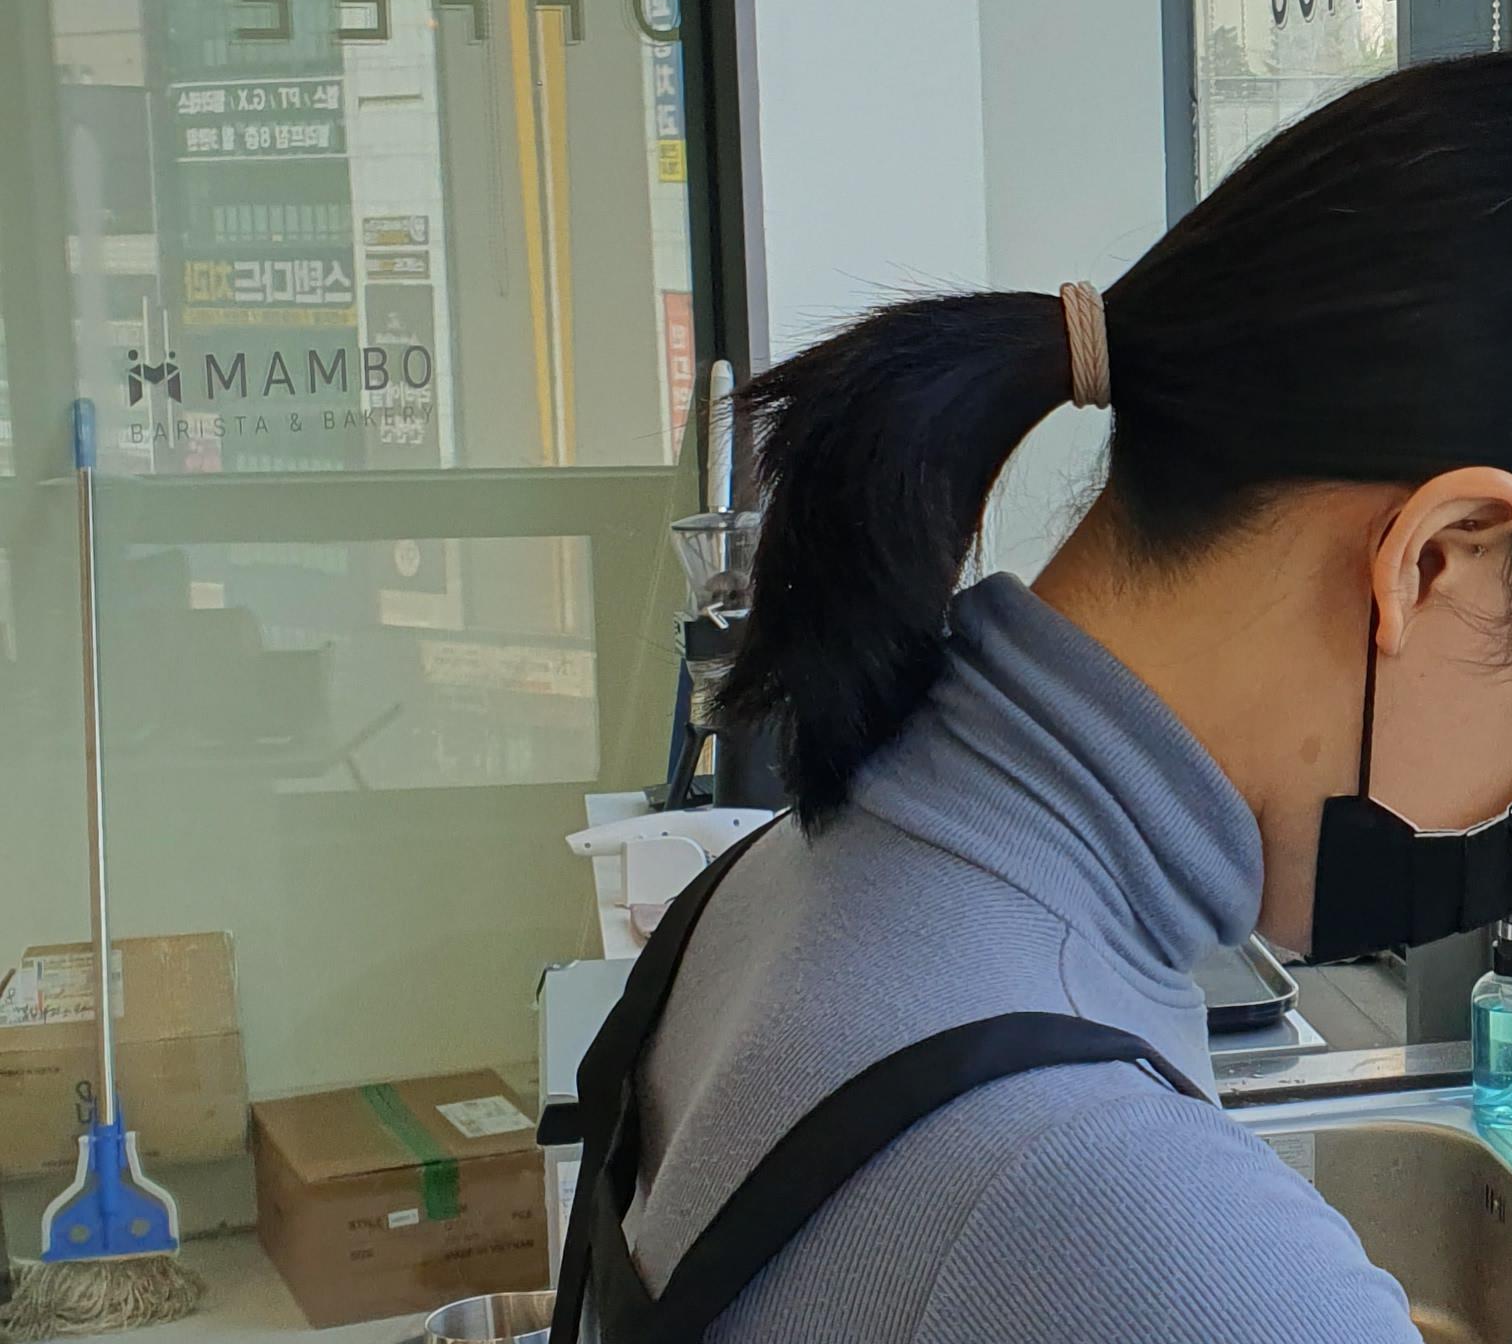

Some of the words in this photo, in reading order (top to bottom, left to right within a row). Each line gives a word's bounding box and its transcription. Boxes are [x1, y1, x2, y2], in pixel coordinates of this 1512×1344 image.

[204, 345, 434, 399] MAMBO
[130, 413, 270, 444] BARISTA
[289, 411, 303, 433] &
[323, 400, 436, 432] BAKERY
